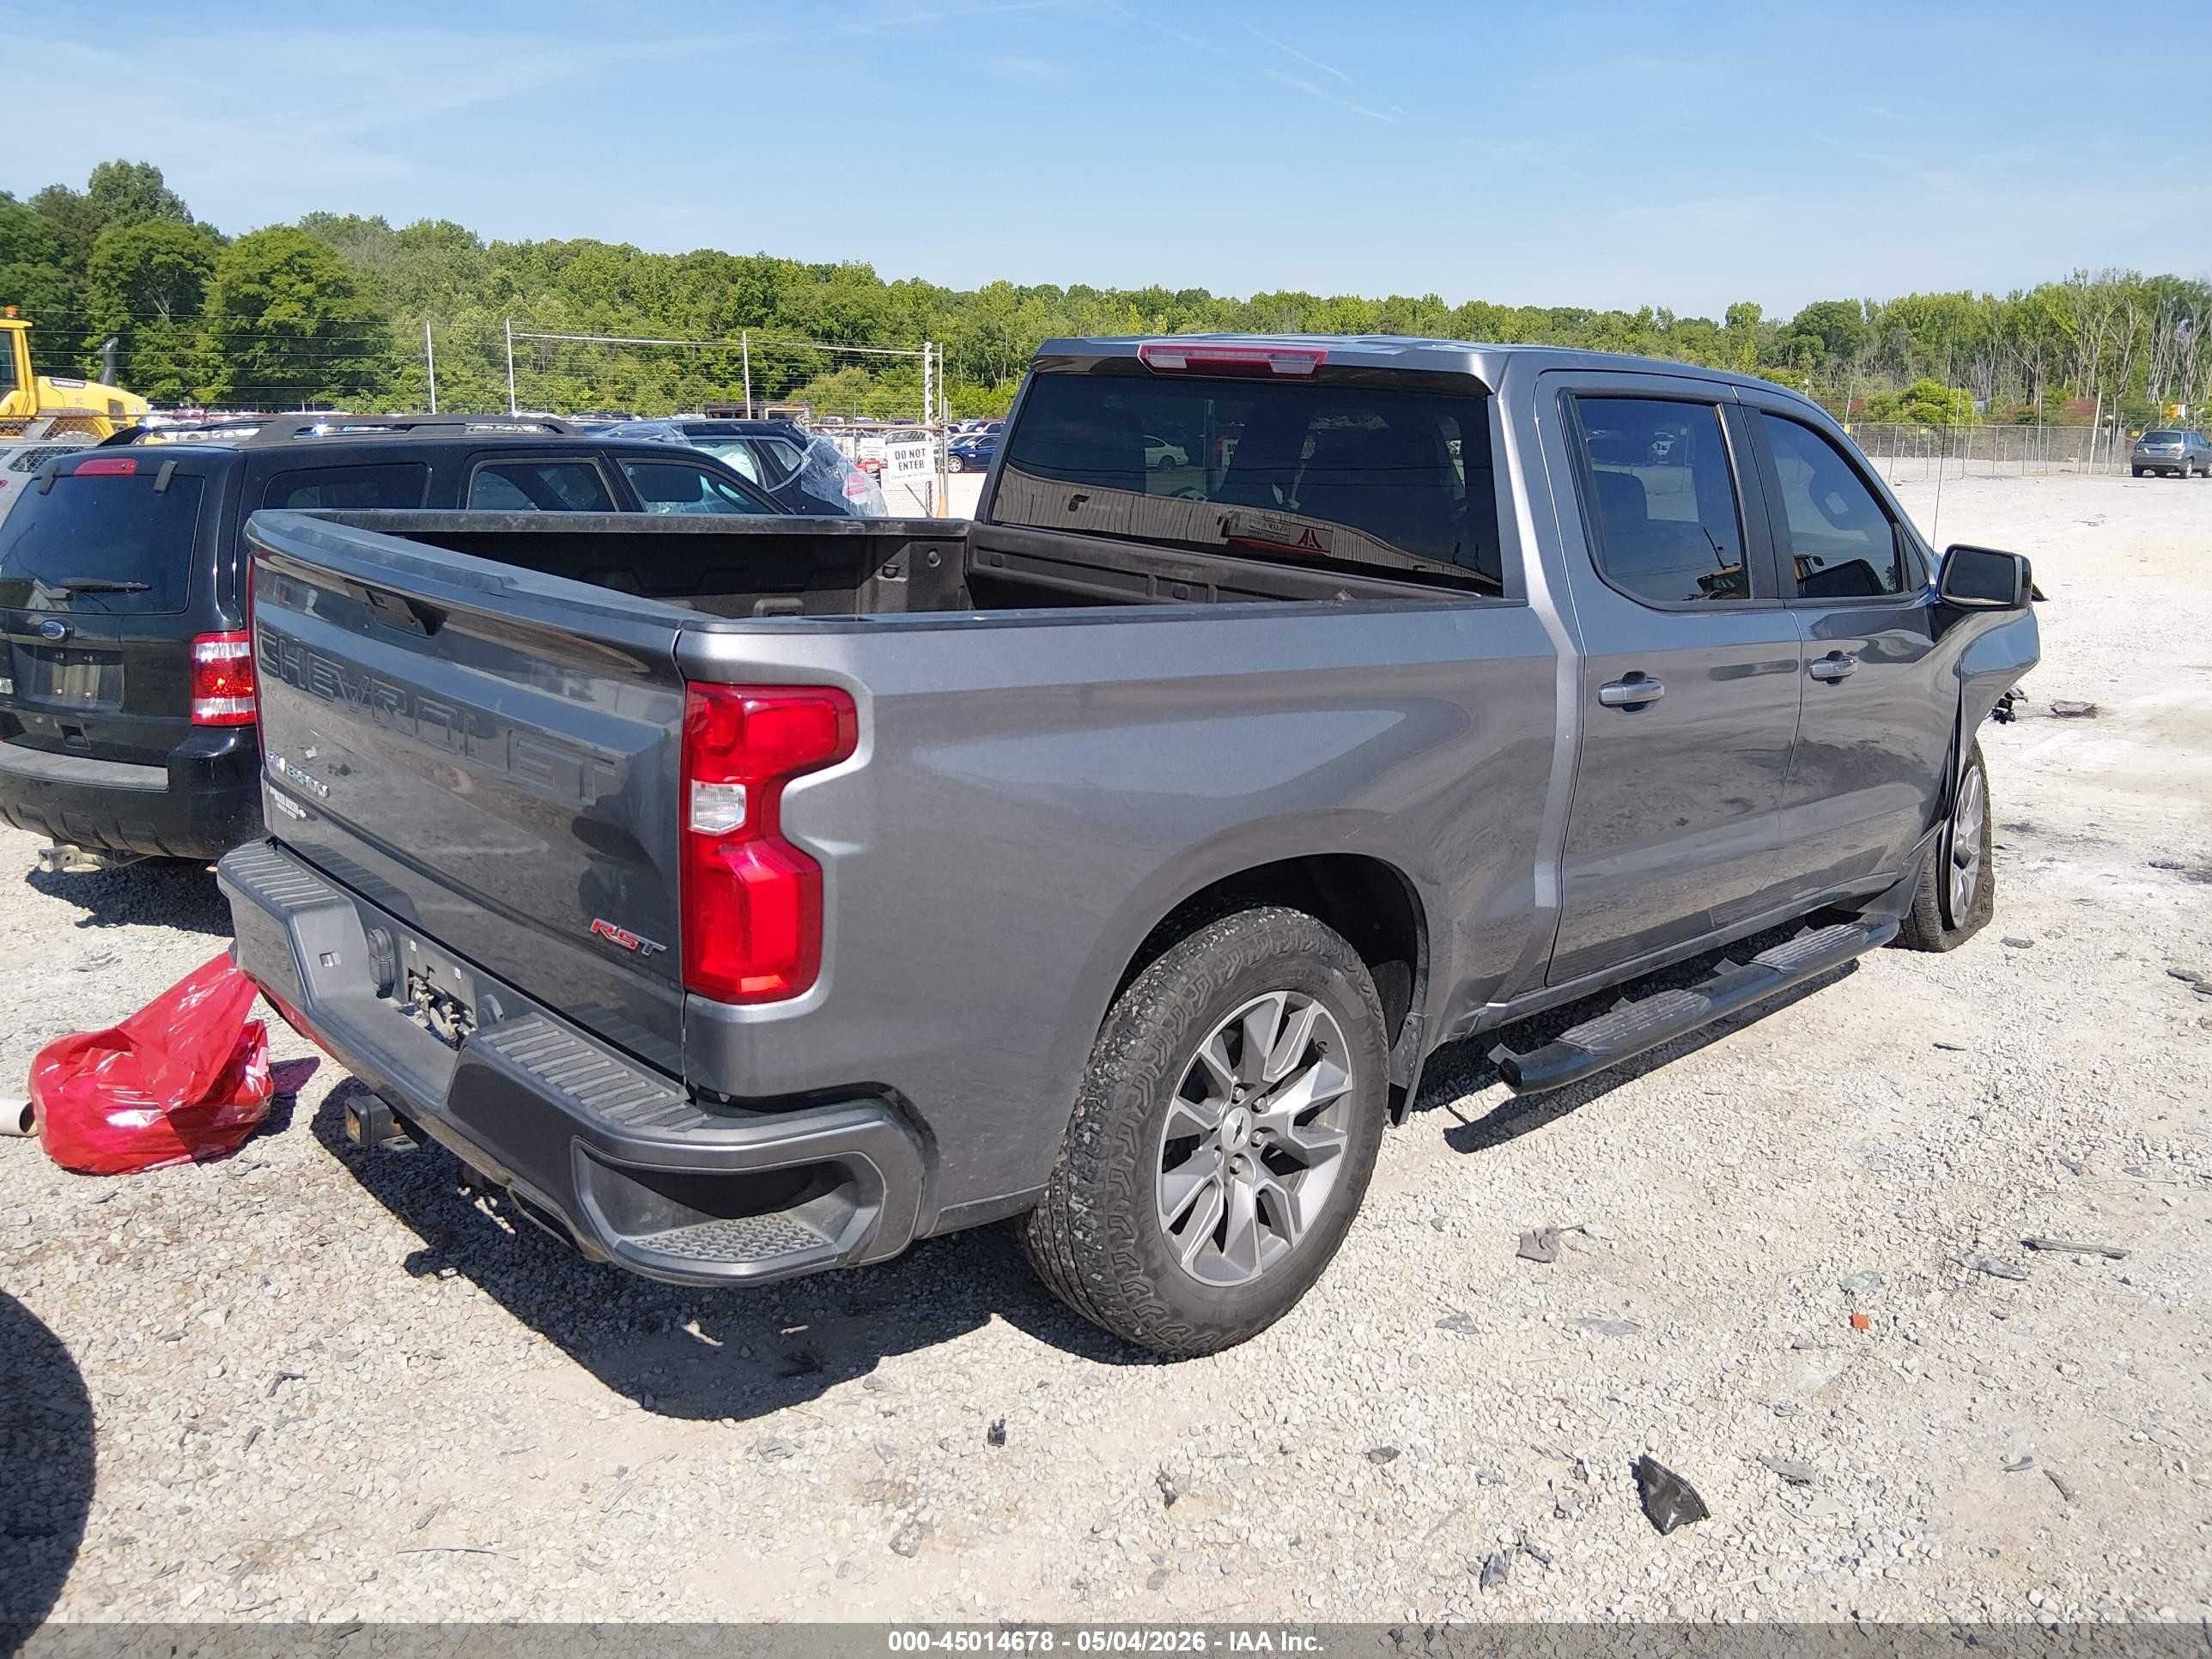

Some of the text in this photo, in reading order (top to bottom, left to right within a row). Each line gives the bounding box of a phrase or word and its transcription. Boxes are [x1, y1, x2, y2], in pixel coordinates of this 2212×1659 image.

[895, 450, 907, 459] DO
[909, 448, 927, 459] NOT
[898, 460, 925, 471] ENTER
[258, 628, 617, 805] CHEVROLET
[590, 917, 667, 956] RST
